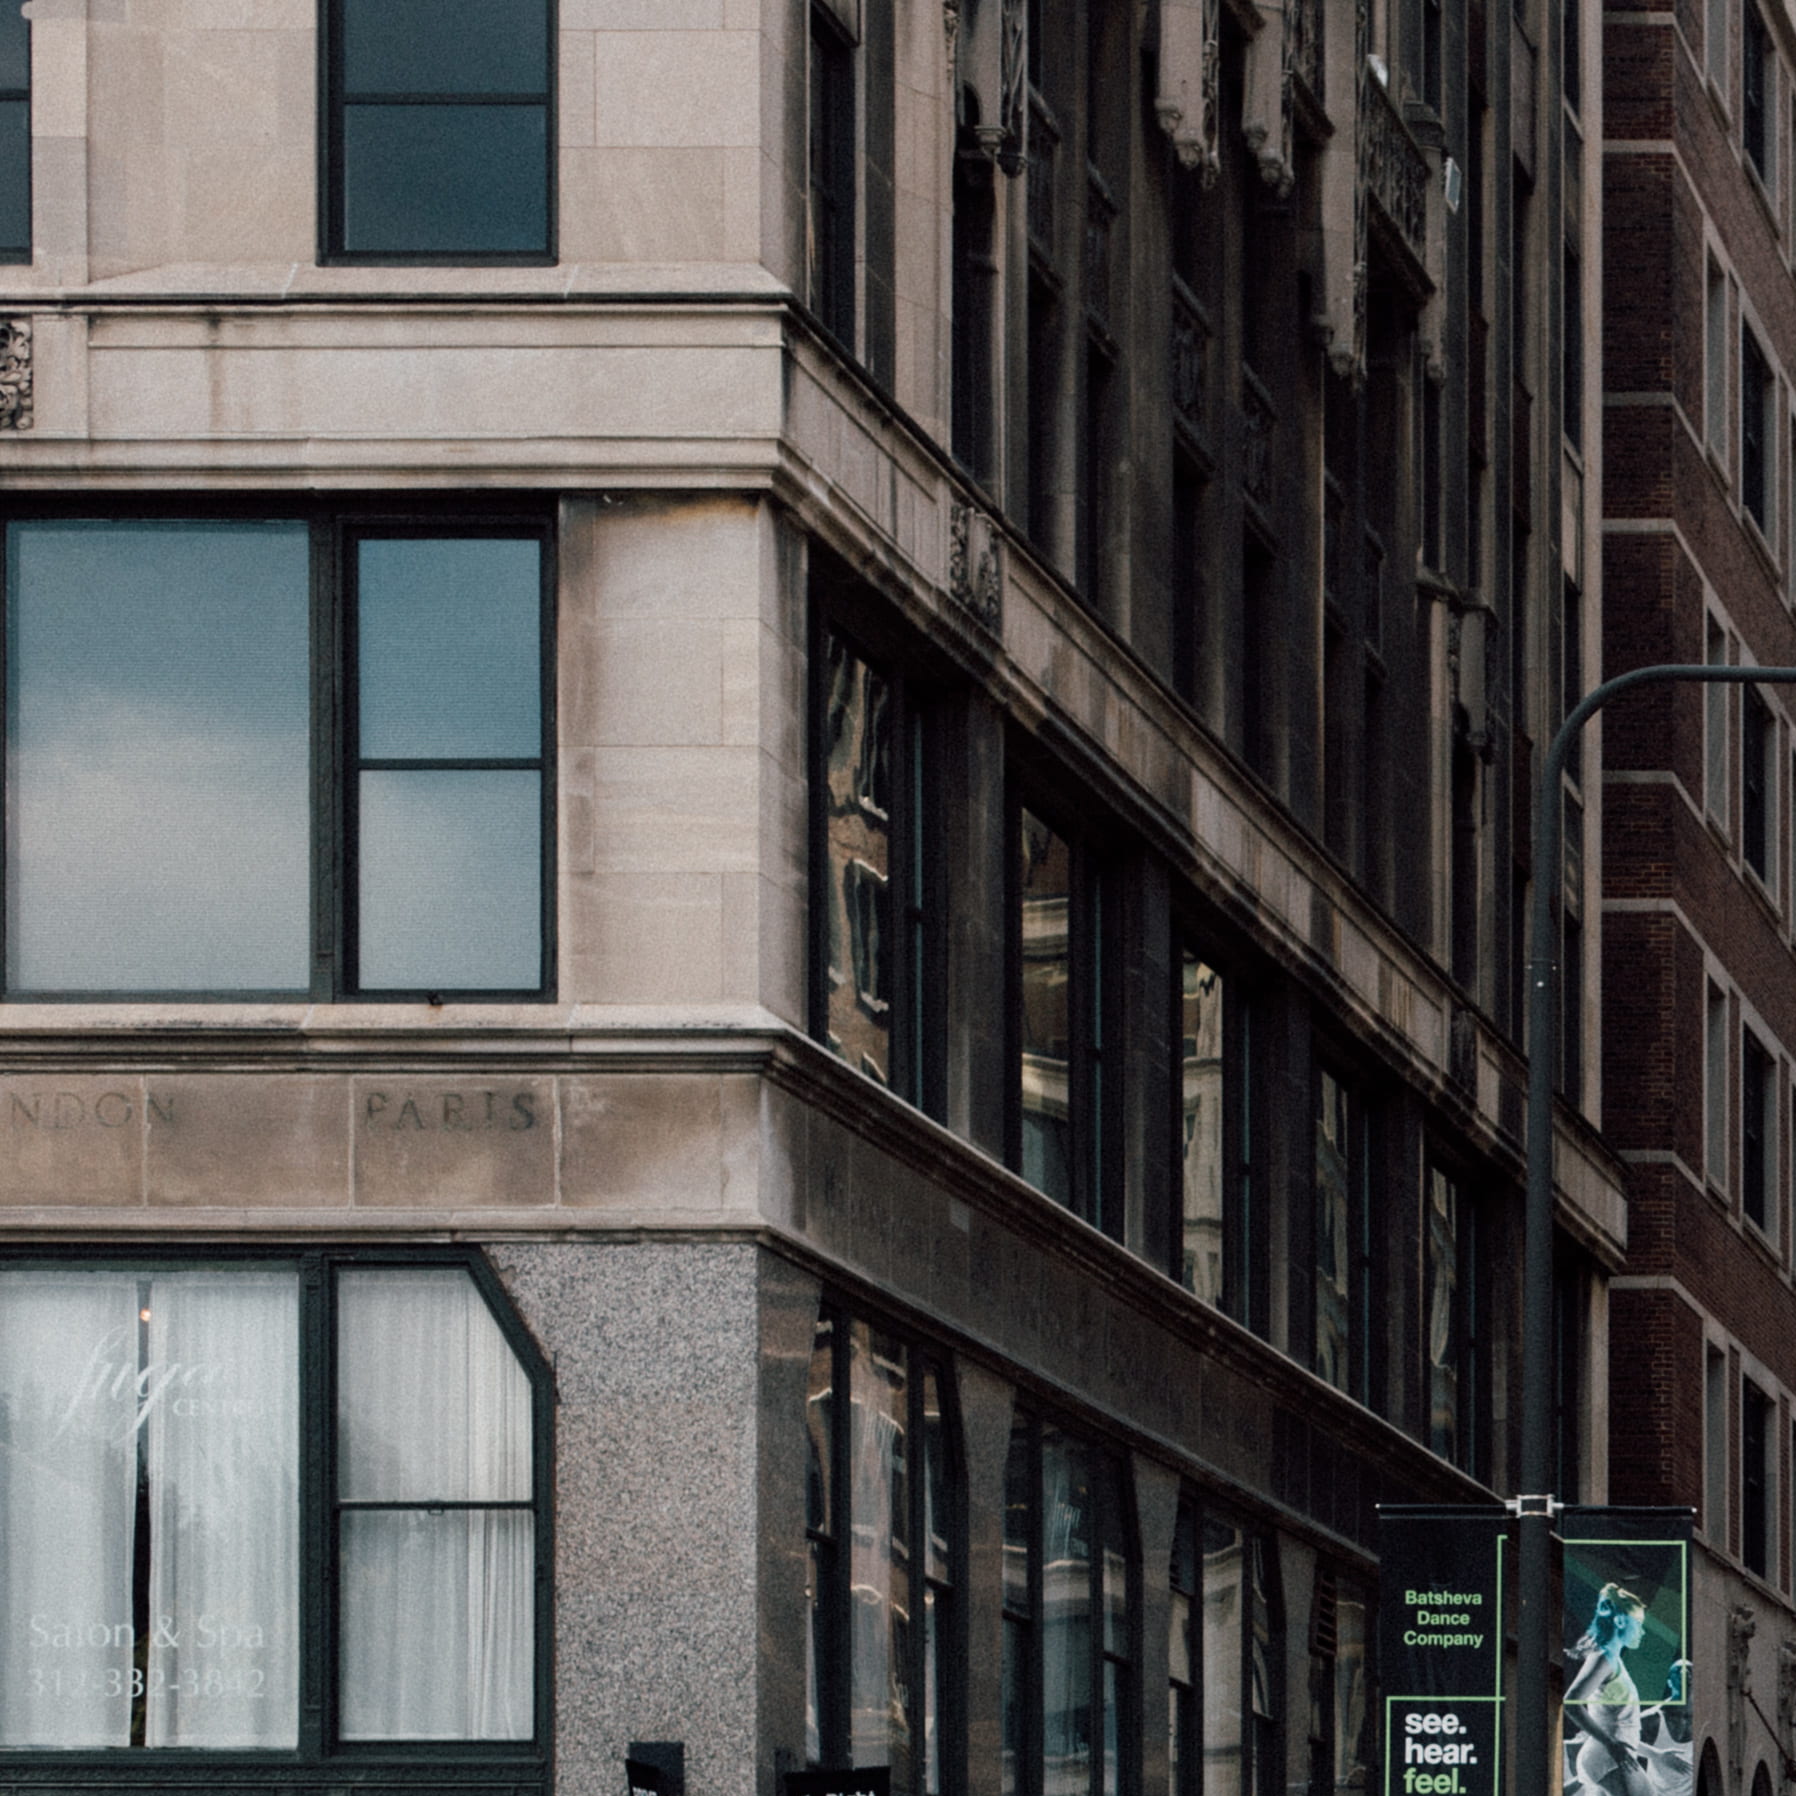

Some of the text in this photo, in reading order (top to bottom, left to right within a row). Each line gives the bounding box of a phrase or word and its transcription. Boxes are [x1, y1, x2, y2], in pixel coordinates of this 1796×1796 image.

[364, 1091, 536, 1131] PARIS
[1404, 1590, 1483, 1606] Batsheva
[1416, 1610, 1470, 1625] Dance
[153, 1616, 181, 1649] &
[1403, 1630, 1484, 1648] Company
[1404, 1712, 1467, 1735] see.
[1404, 1738, 1478, 1765] hear.
[1403, 1768, 1467, 1795] feel.
